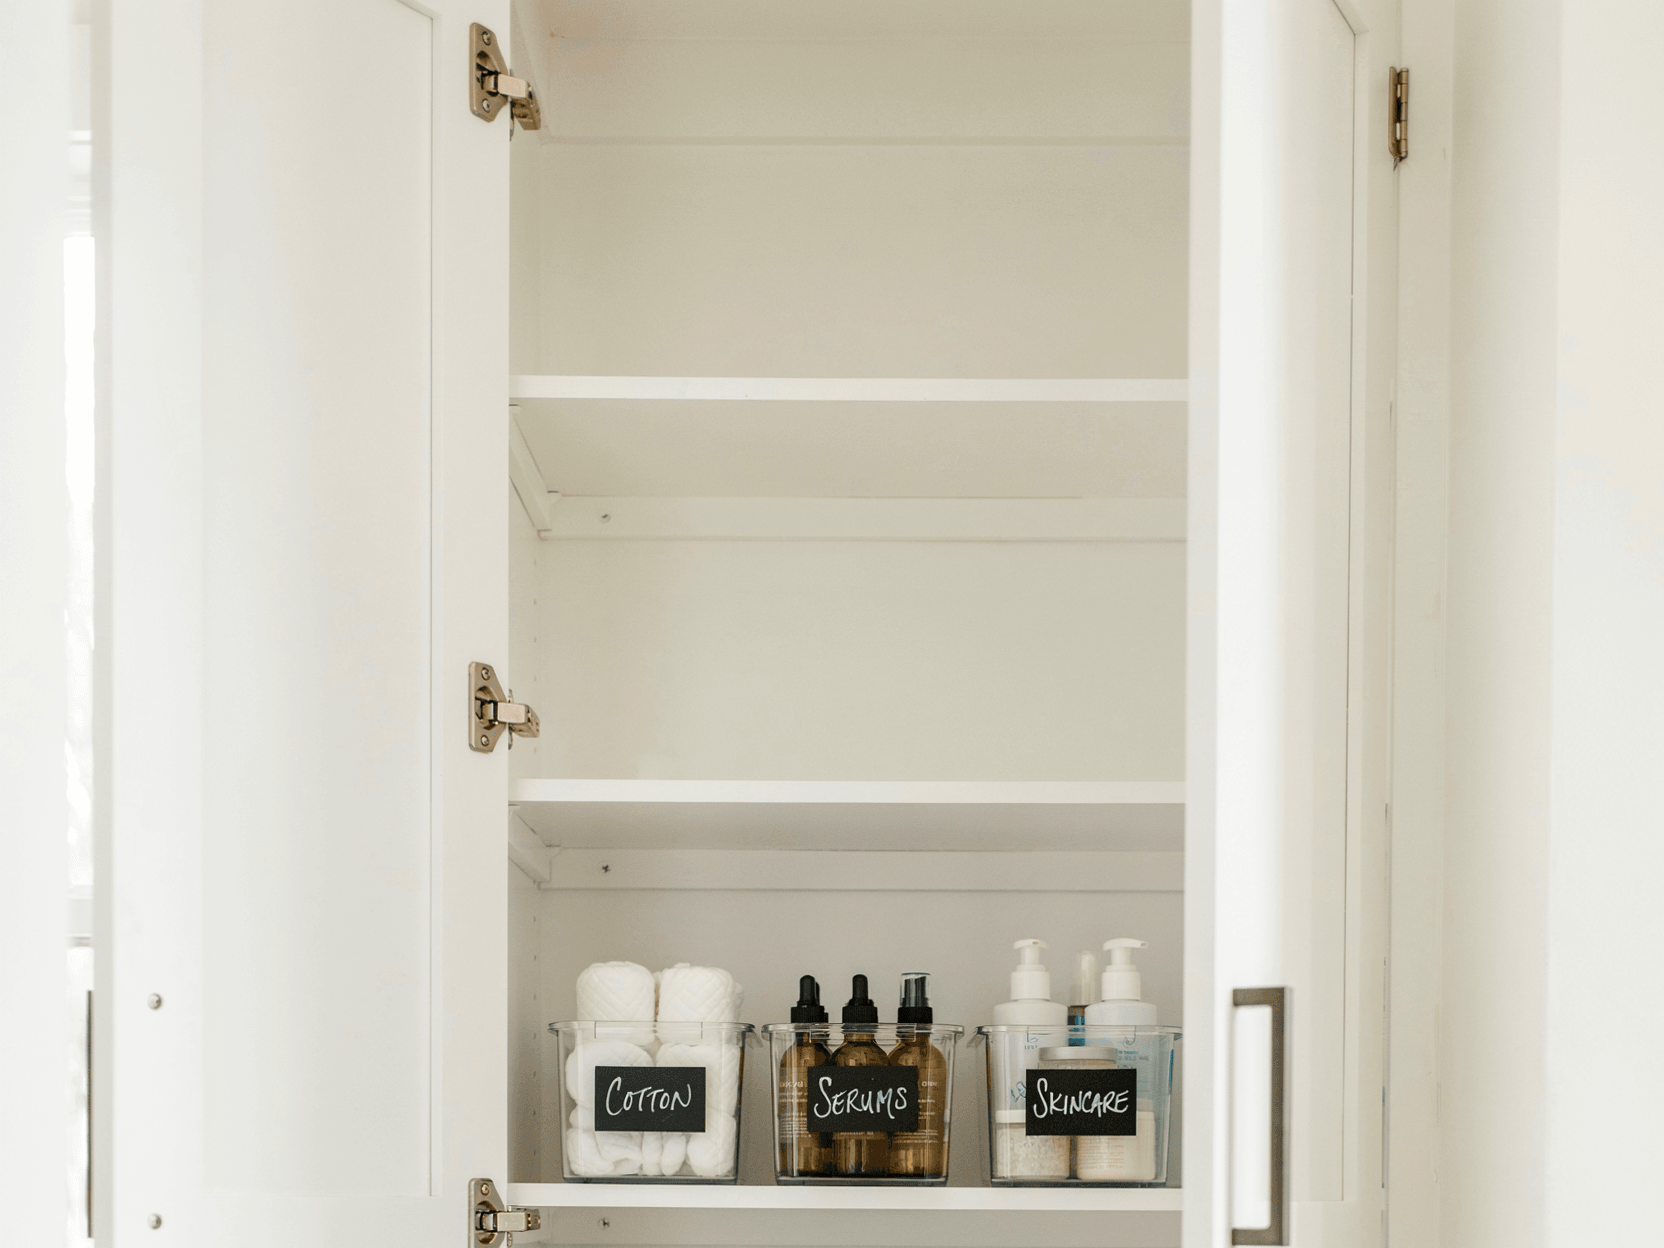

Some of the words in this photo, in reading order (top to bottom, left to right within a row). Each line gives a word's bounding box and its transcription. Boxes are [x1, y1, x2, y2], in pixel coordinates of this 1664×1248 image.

[605, 1076, 692, 1116] COTTON
[813, 1076, 908, 1120] SERUMS
[1032, 1077, 1129, 1119] SKINCARE
